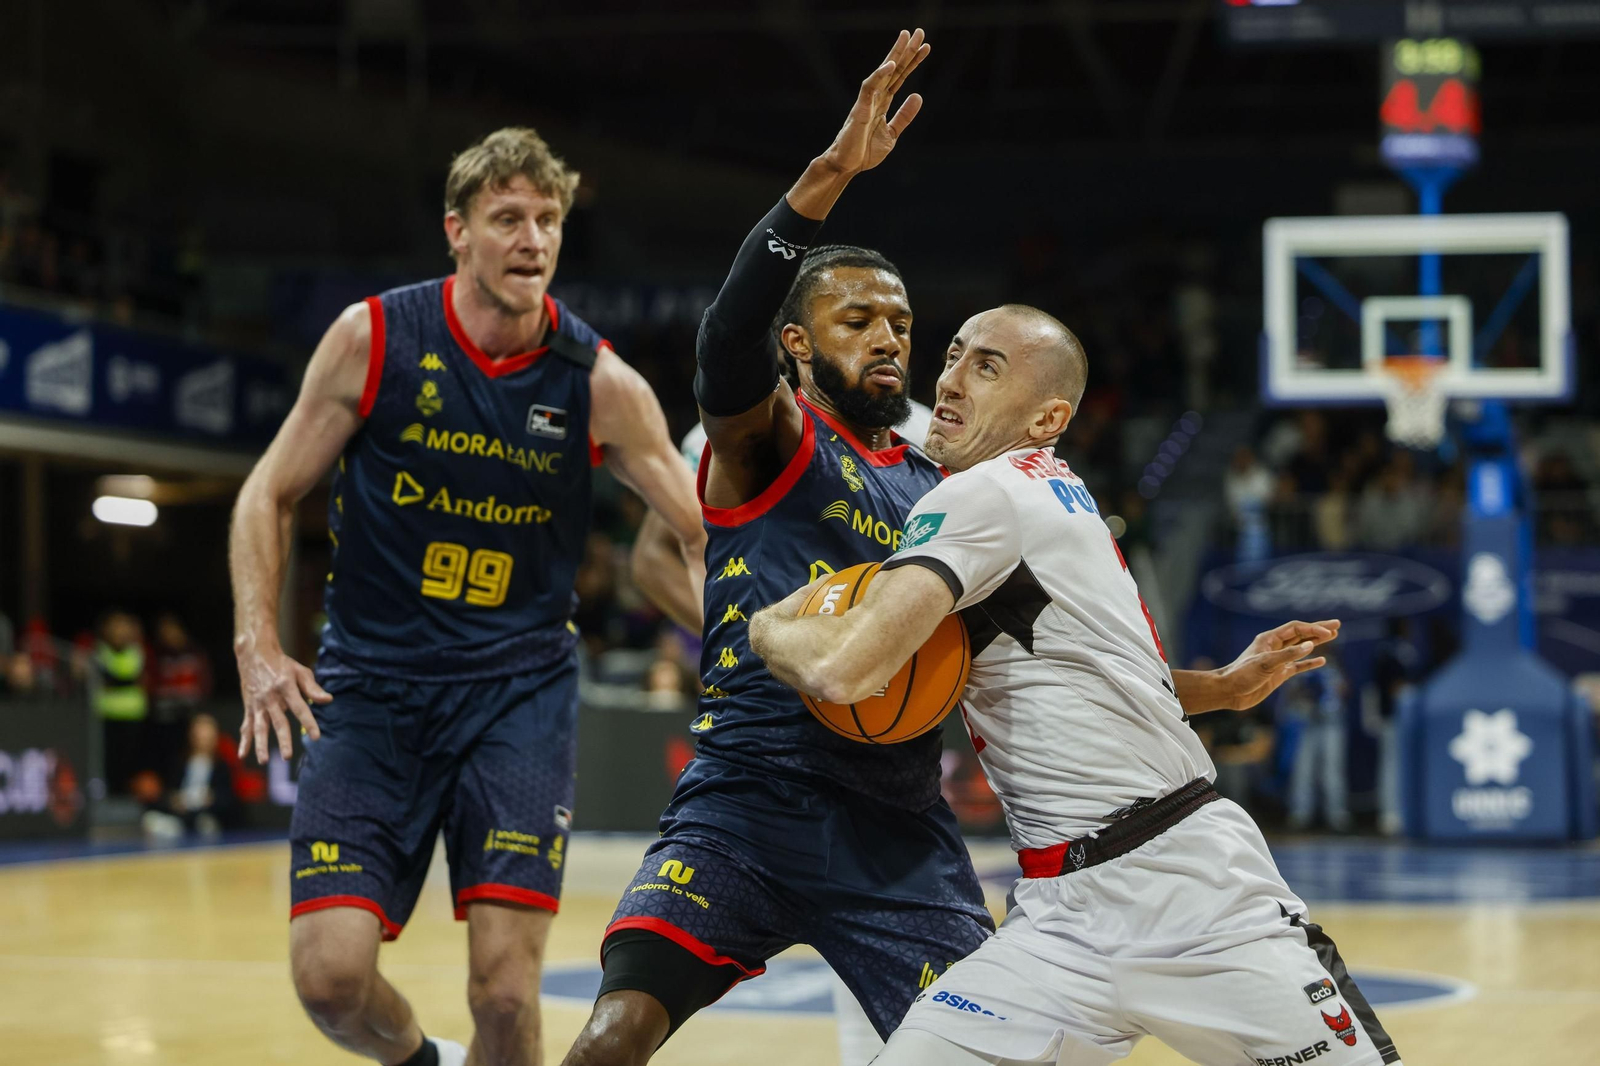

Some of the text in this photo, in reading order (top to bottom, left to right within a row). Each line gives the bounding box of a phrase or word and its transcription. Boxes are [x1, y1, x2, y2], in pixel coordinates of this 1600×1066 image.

[420, 541, 514, 608] 99
[671, 885, 684, 896] la
[1311, 986, 1332, 1001] acb
[1256, 1040, 1332, 1066] BERNER
